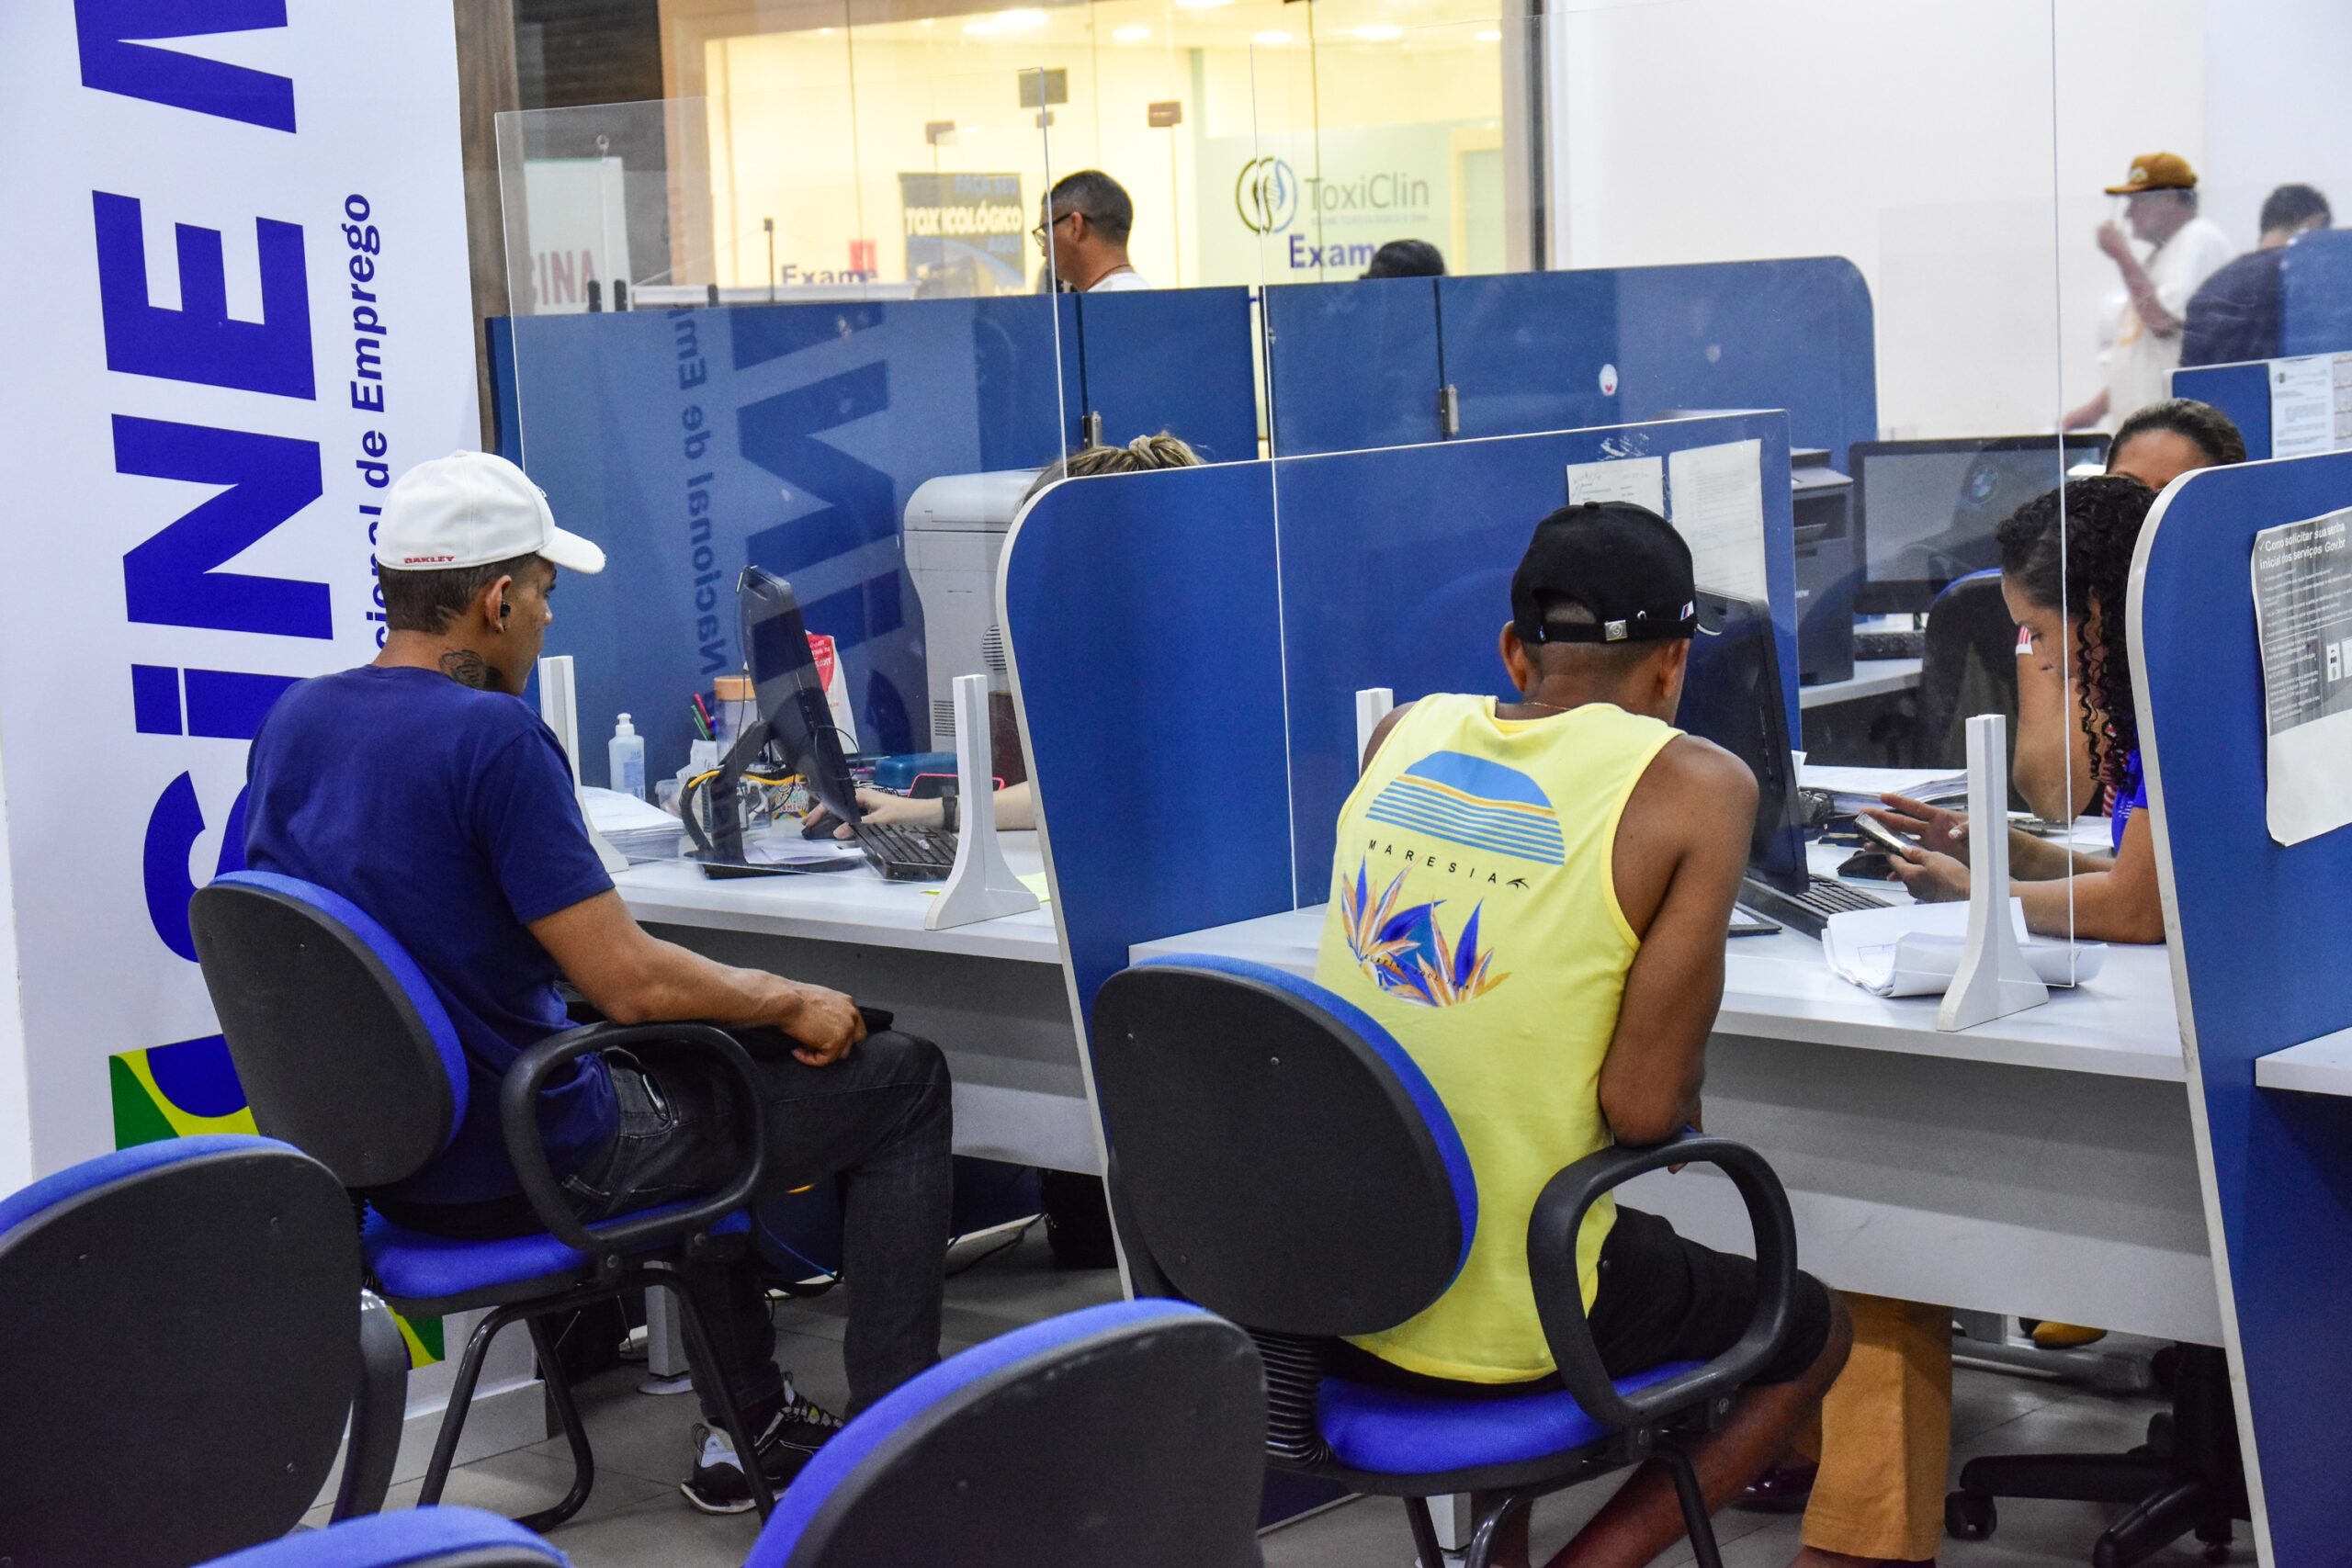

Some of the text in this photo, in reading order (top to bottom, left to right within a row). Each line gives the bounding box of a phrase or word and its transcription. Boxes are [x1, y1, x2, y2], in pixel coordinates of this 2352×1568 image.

[1305, 174, 1429, 211] ToxiClin
[904, 199, 1023, 235] TOXICOLÓGICO
[530, 249, 595, 305] INA
[341, 194, 387, 413] Emprego
[356, 430, 388, 489] de
[2265, 523, 2346, 551] Como solicitar sua senha
[2259, 556, 2281, 570] inicial
[2282, 553, 2292, 563] dos
[2293, 546, 2323, 559] serviços
[1368, 839, 1498, 884] MARESIA
